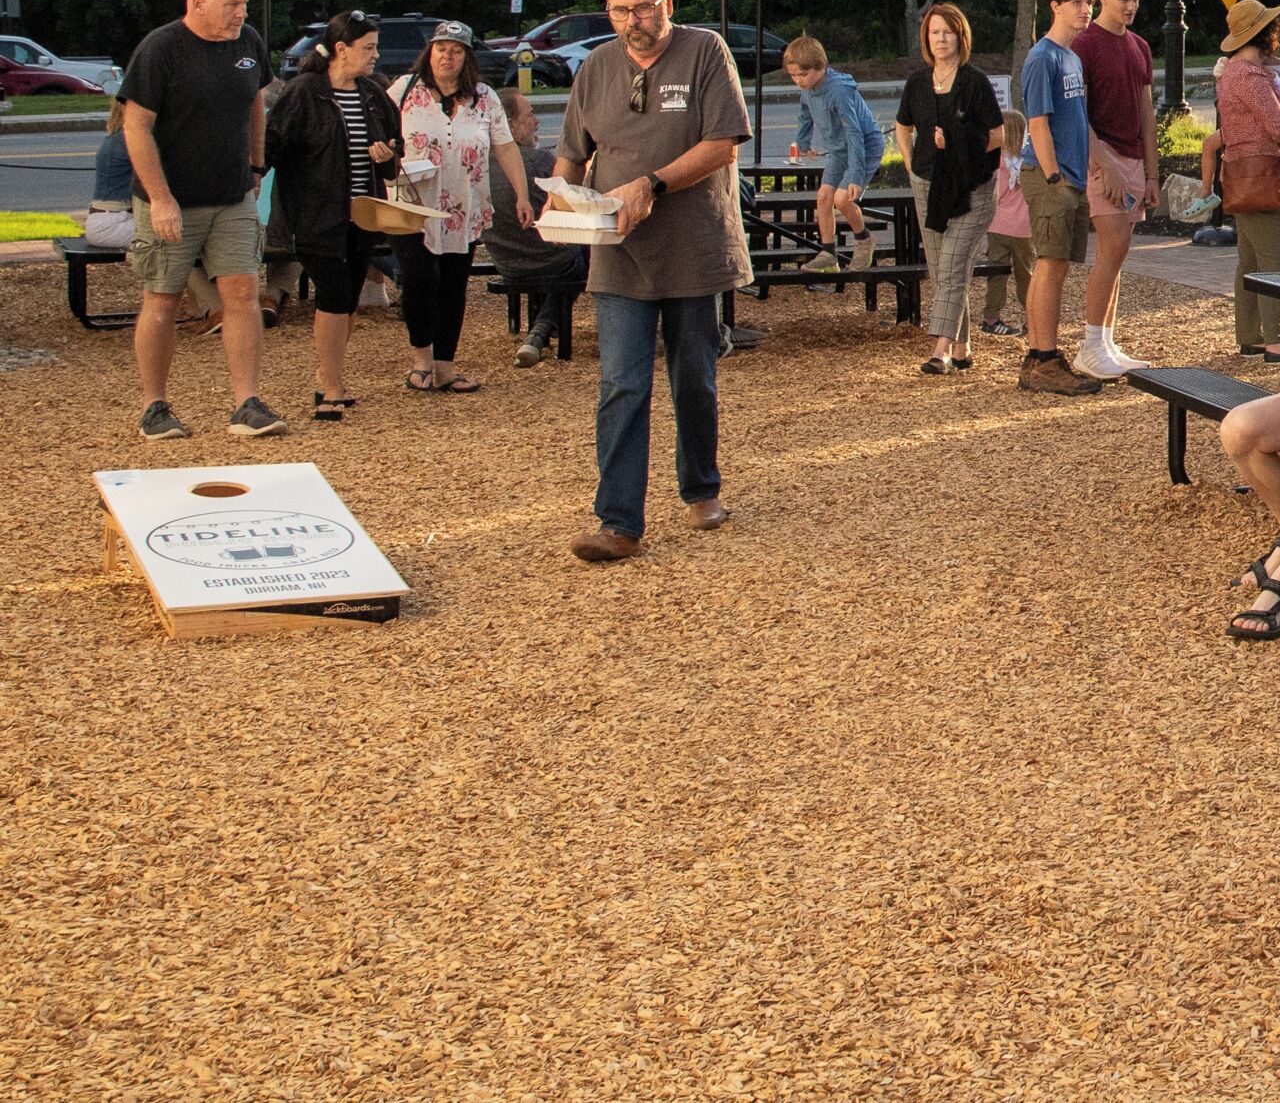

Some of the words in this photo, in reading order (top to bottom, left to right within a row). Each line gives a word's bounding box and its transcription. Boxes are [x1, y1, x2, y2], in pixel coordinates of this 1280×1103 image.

[660, 84, 689, 93] KIAWAH
[155, 524, 335, 542] TIDELINE
[204, 573, 307, 588] ESTABLISHED
[309, 569, 350, 580] 2023
[245, 584, 305, 594] DURHAM,
[308, 582, 327, 590] NH
